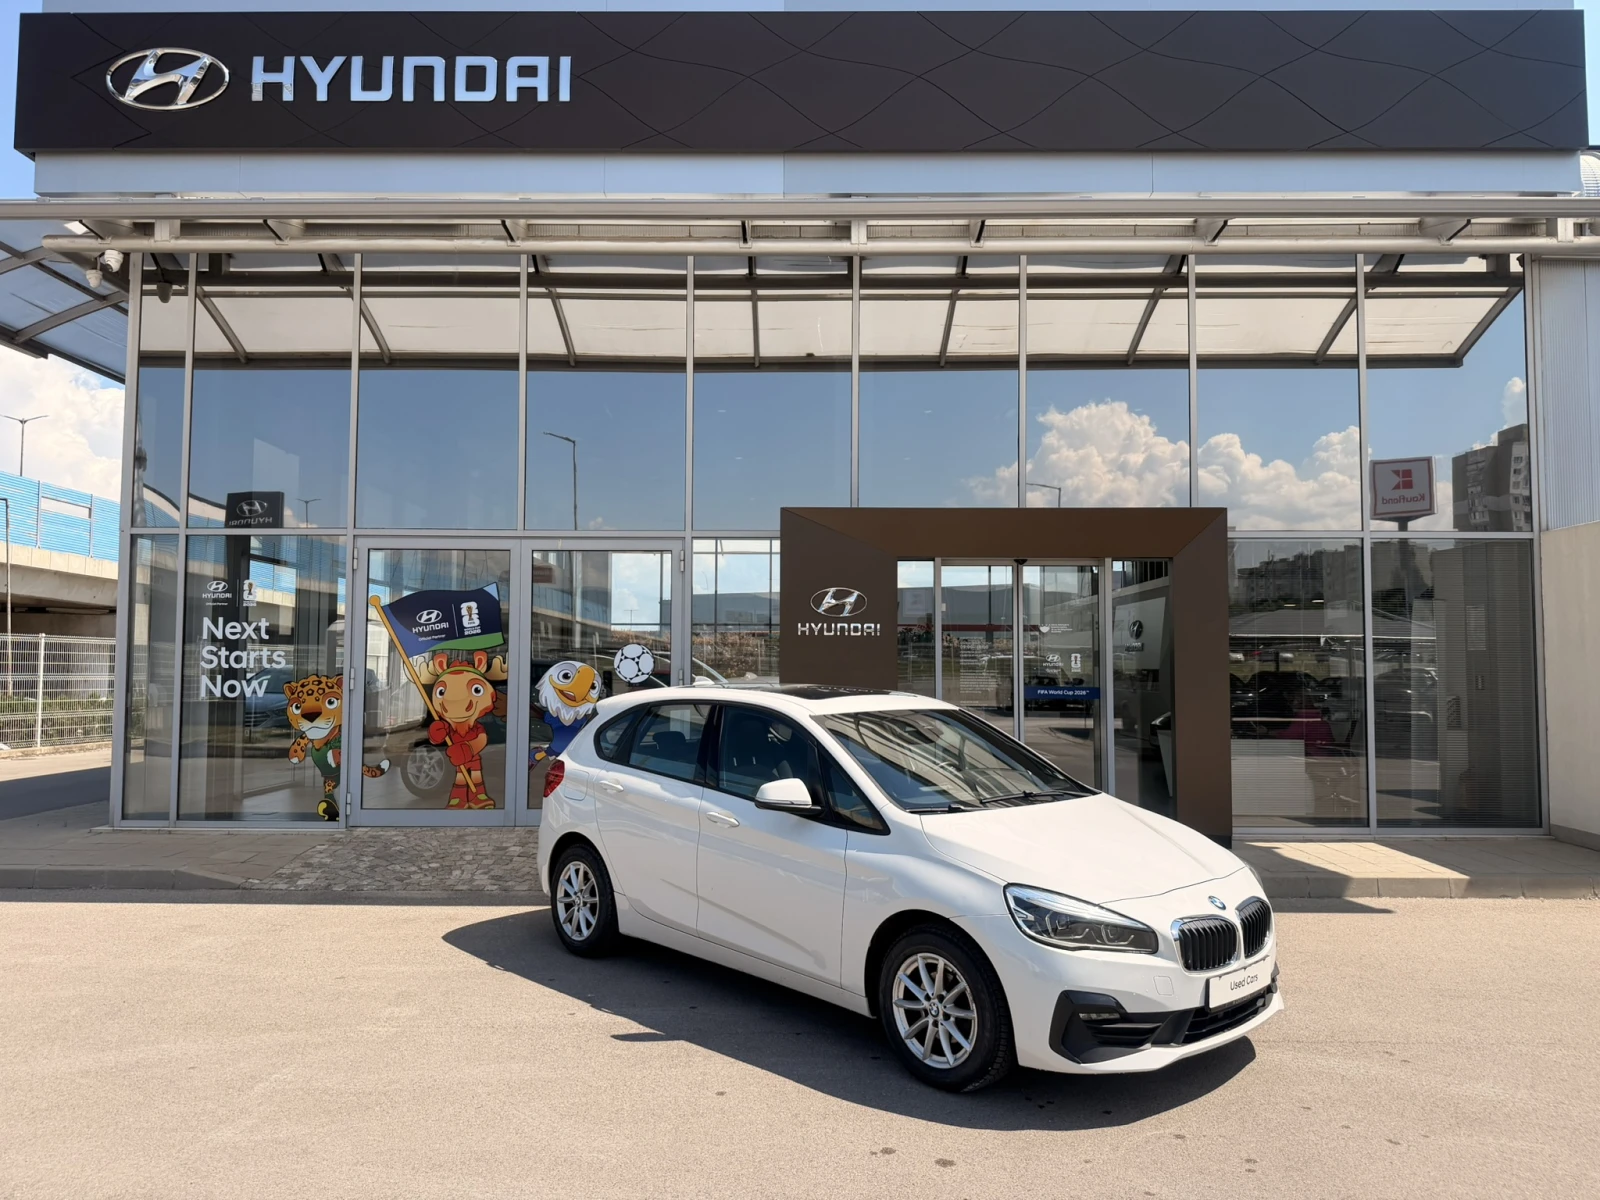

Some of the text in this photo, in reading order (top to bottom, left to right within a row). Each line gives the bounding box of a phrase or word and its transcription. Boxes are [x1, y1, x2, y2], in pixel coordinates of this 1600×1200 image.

[251, 55, 572, 103] HYUNDAI
[202, 616, 270, 640] Next
[412, 621, 449, 634] HYUNDAI
[797, 622, 880, 637] HYUNDAI
[200, 645, 286, 669] Starts
[200, 675, 269, 698] Now
[1230, 974, 1258, 991] Used Cars
